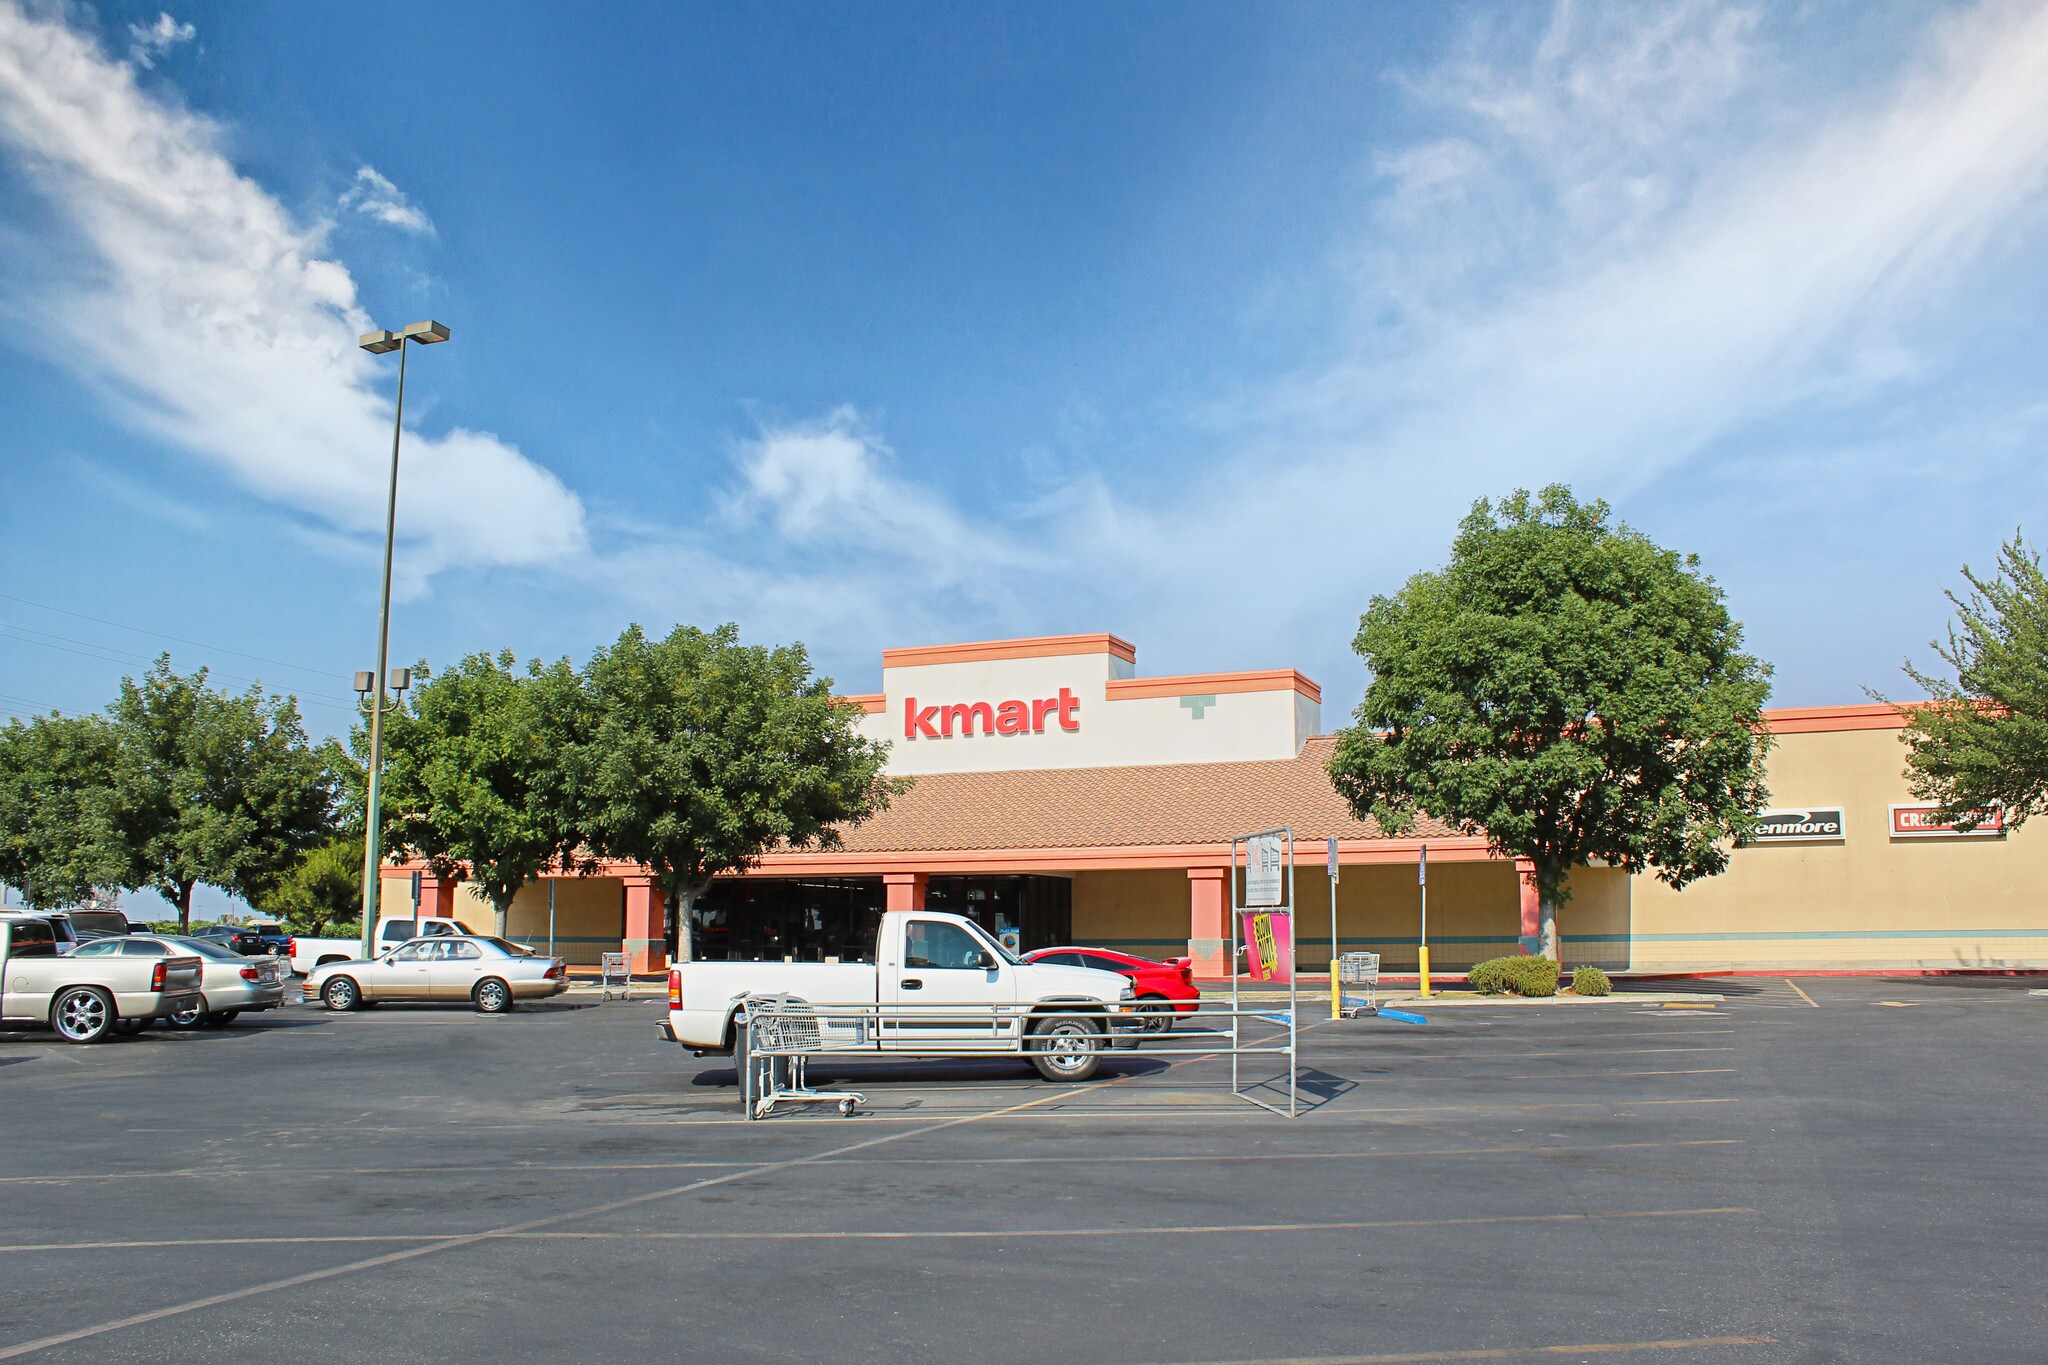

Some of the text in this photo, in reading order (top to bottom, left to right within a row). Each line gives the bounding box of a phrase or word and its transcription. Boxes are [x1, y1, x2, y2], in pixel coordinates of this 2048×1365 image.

[905, 687, 1079, 738] kmart
[1749, 821, 1838, 835] enmore
[1255, 916, 1271, 940] BLOW
